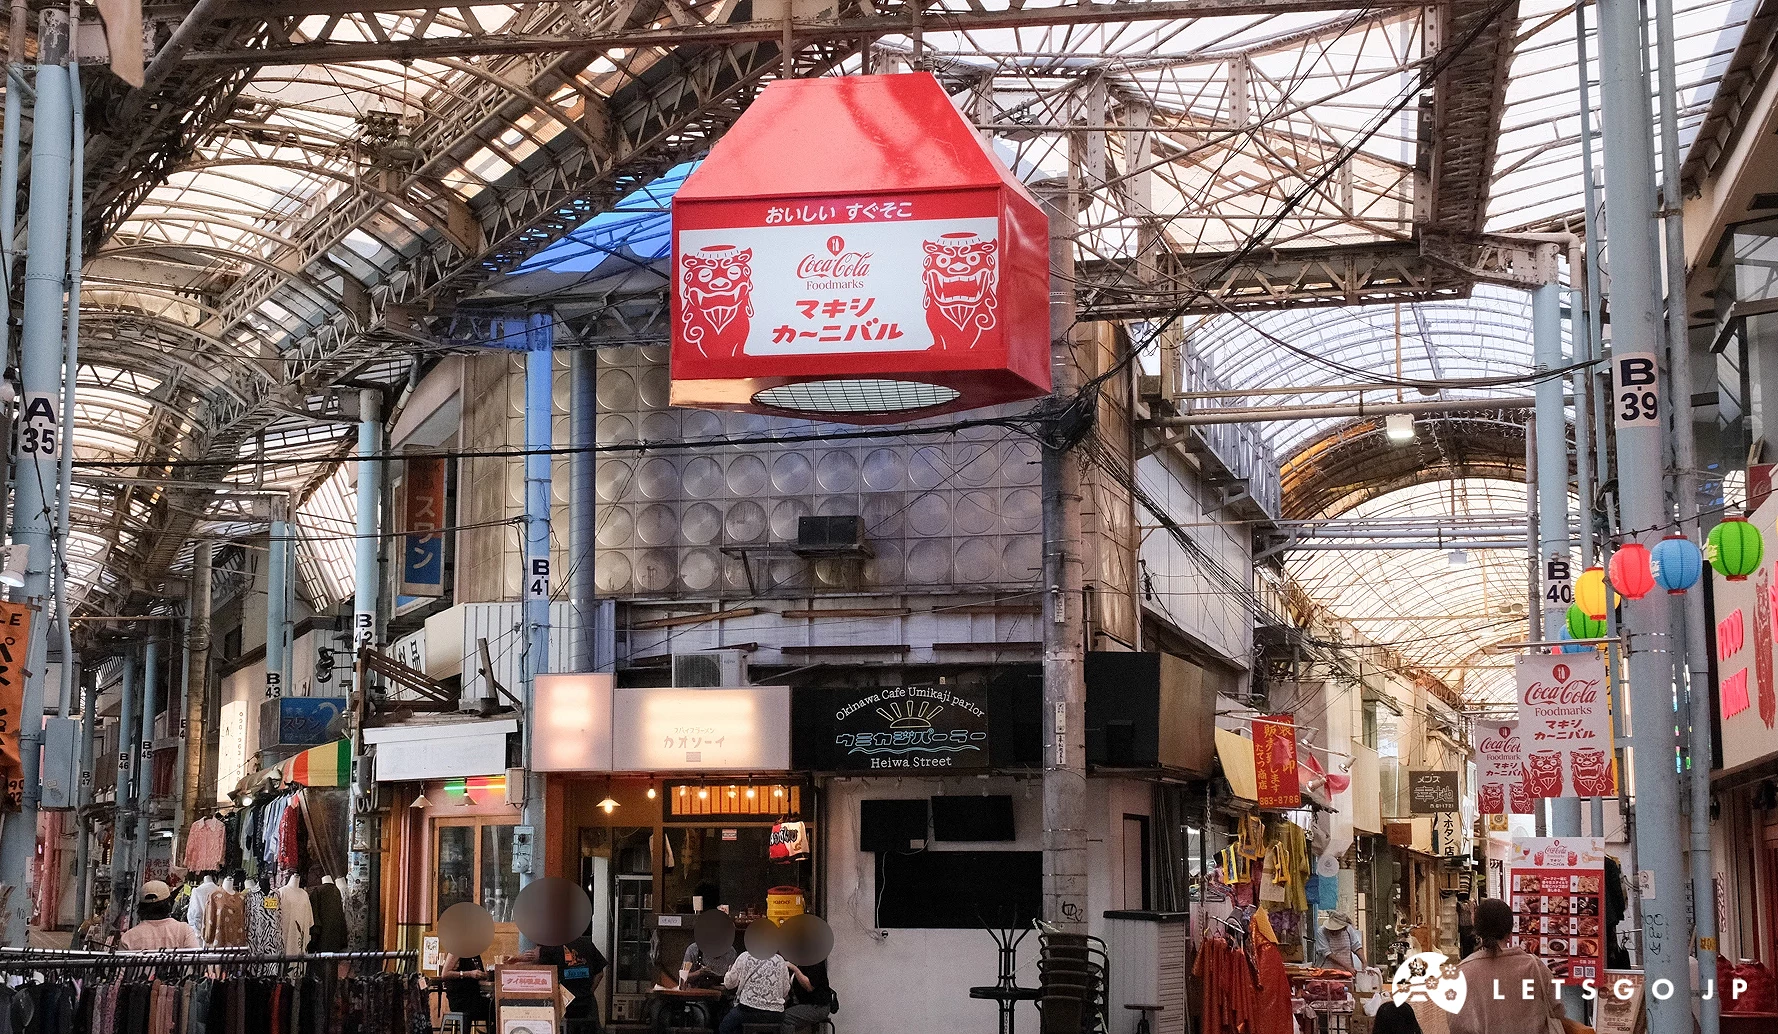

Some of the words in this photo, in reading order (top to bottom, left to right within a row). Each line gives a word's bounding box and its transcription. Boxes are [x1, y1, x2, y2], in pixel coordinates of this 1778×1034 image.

[765, 205, 836, 225] おいしい
[846, 202, 913, 221] すぐそこ
[797, 251, 874, 278] Coca-Cola
[806, 280, 864, 291] Foodmarks
[795, 297, 876, 319] マキシ
[1620, 392, 1658, 421] 39
[21, 428, 55, 455] 35
[413, 495, 436, 570] スワン
[531, 579, 549, 596] 41
[1546, 584, 1572, 603] 40
[354, 631, 373, 646] 42
[265, 686, 281, 698] 43
[1524, 679, 1600, 706] Coca-Cola
[835, 692, 881, 721] Okinawa
[881, 687, 906, 700] Cafe
[907, 686, 952, 703] Umikaji
[950, 697, 985, 718] parlor
[1535, 706, 1592, 717] Foodmarks
[1545, 719, 1583, 730] マキシ
[663, 735, 726, 749] カオソーイ
[835, 727, 987, 747] ウミカジパーラー
[1279, 720, 1296, 775] 製卸
[118, 762, 129, 770] 46
[870, 757, 910, 769] Heiwa
[913, 756, 952, 767] Street
[1417, 773, 1441, 783] メンズ
[1259, 795, 1300, 806] 863-8786
